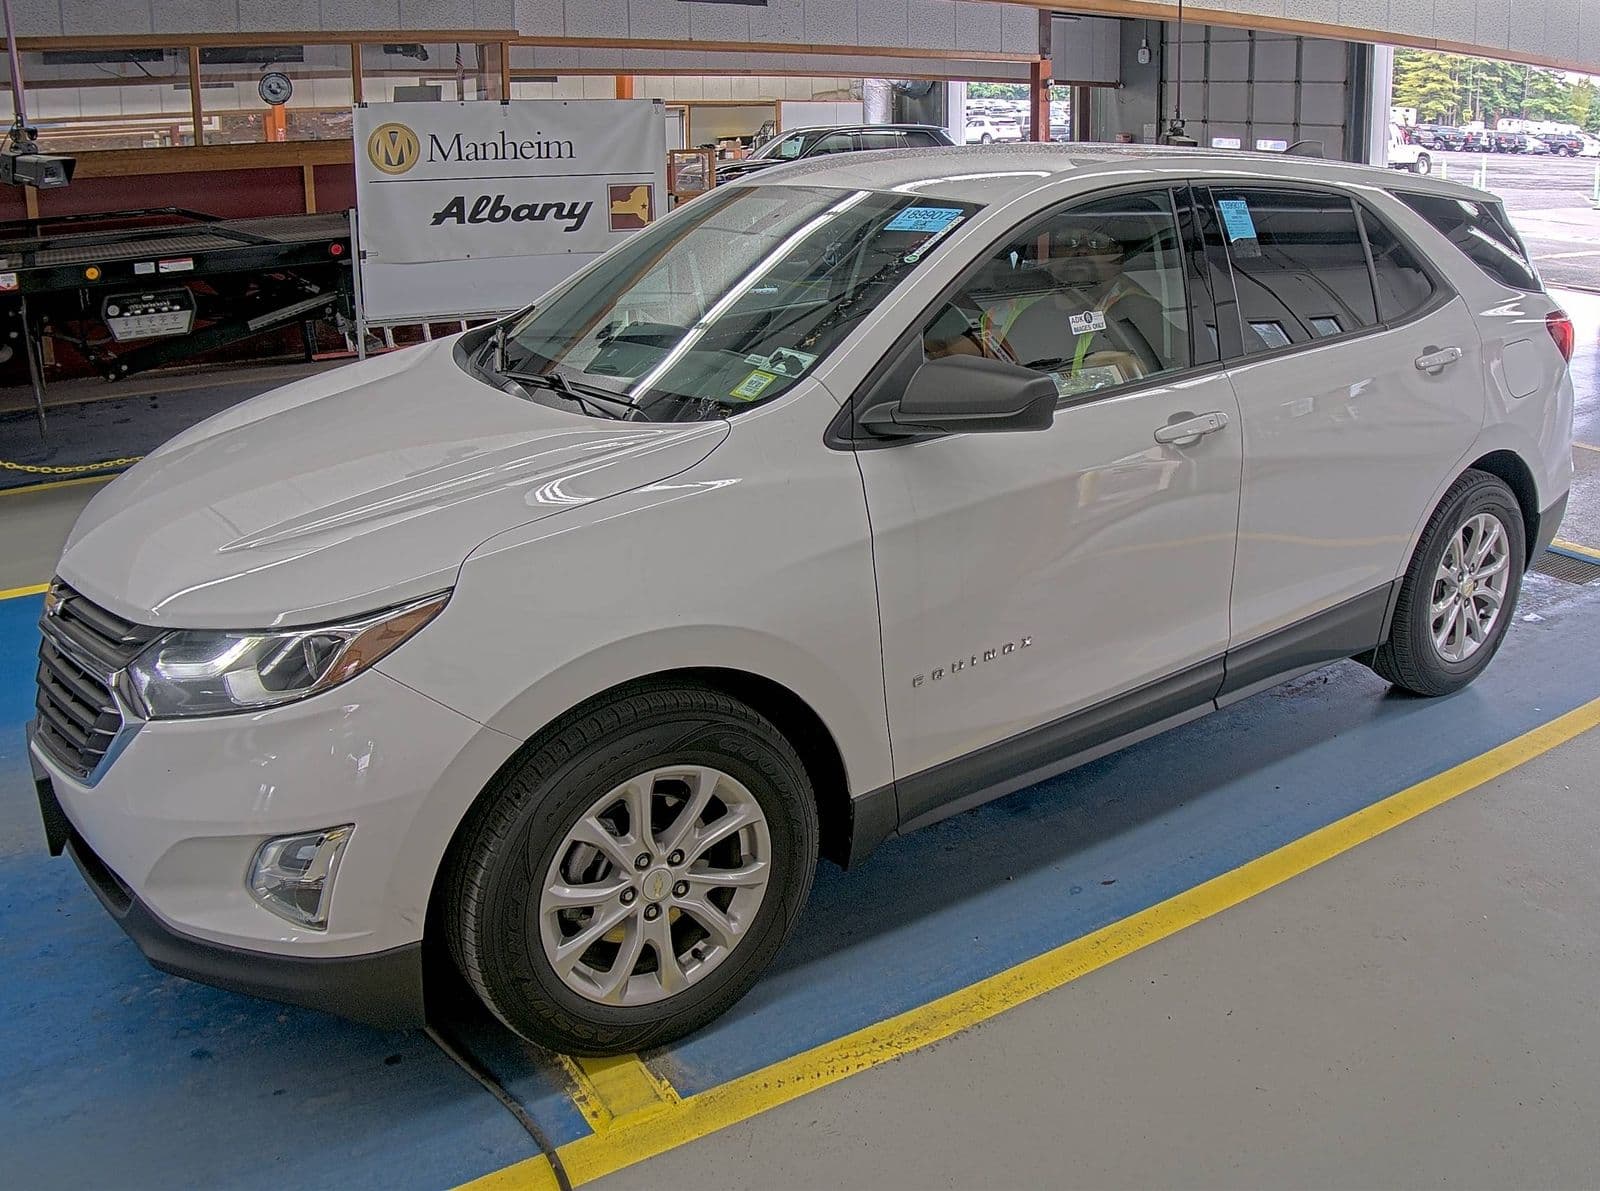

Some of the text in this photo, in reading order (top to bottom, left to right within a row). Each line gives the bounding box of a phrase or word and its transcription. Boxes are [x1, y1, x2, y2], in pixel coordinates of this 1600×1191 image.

[426, 131, 576, 163] Manheim
[430, 195, 594, 233] Albany
[902, 208, 960, 221] 1899072
[1071, 316, 1084, 324] ADK
[1092, 322, 1104, 330] ONLY
[911, 636, 1032, 687] EQUINOX
